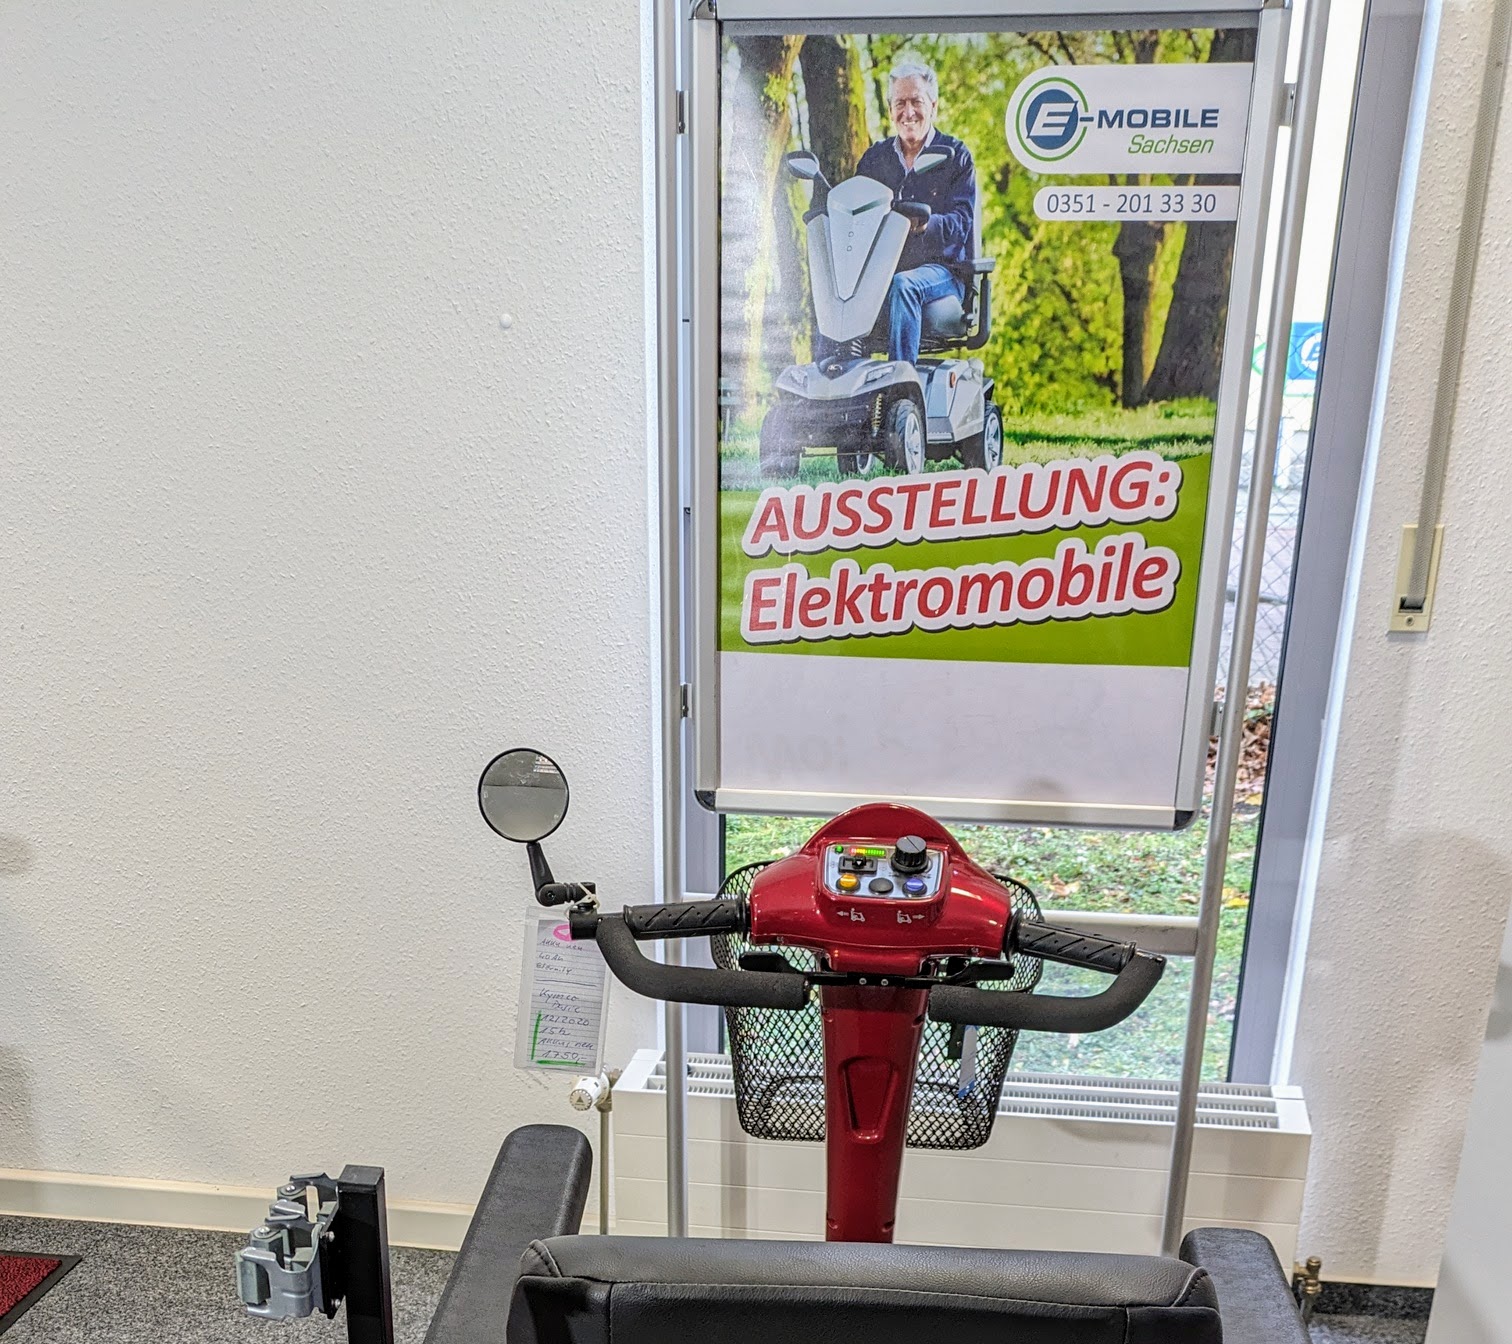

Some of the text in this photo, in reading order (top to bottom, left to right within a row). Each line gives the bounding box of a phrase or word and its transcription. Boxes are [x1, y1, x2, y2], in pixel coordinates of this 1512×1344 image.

[1026, 100, 1220, 139] E-MOBILE
[1127, 134, 1215, 154] Sachsen
[1046, 193, 1096, 214] 0351
[1116, 193, 1153, 214] 201
[1159, 193, 1185, 214] 33
[1190, 193, 1217, 214] 30
[750, 460, 1170, 545] AUSSTELLUNG:
[748, 541, 1169, 633] Elektromobile
